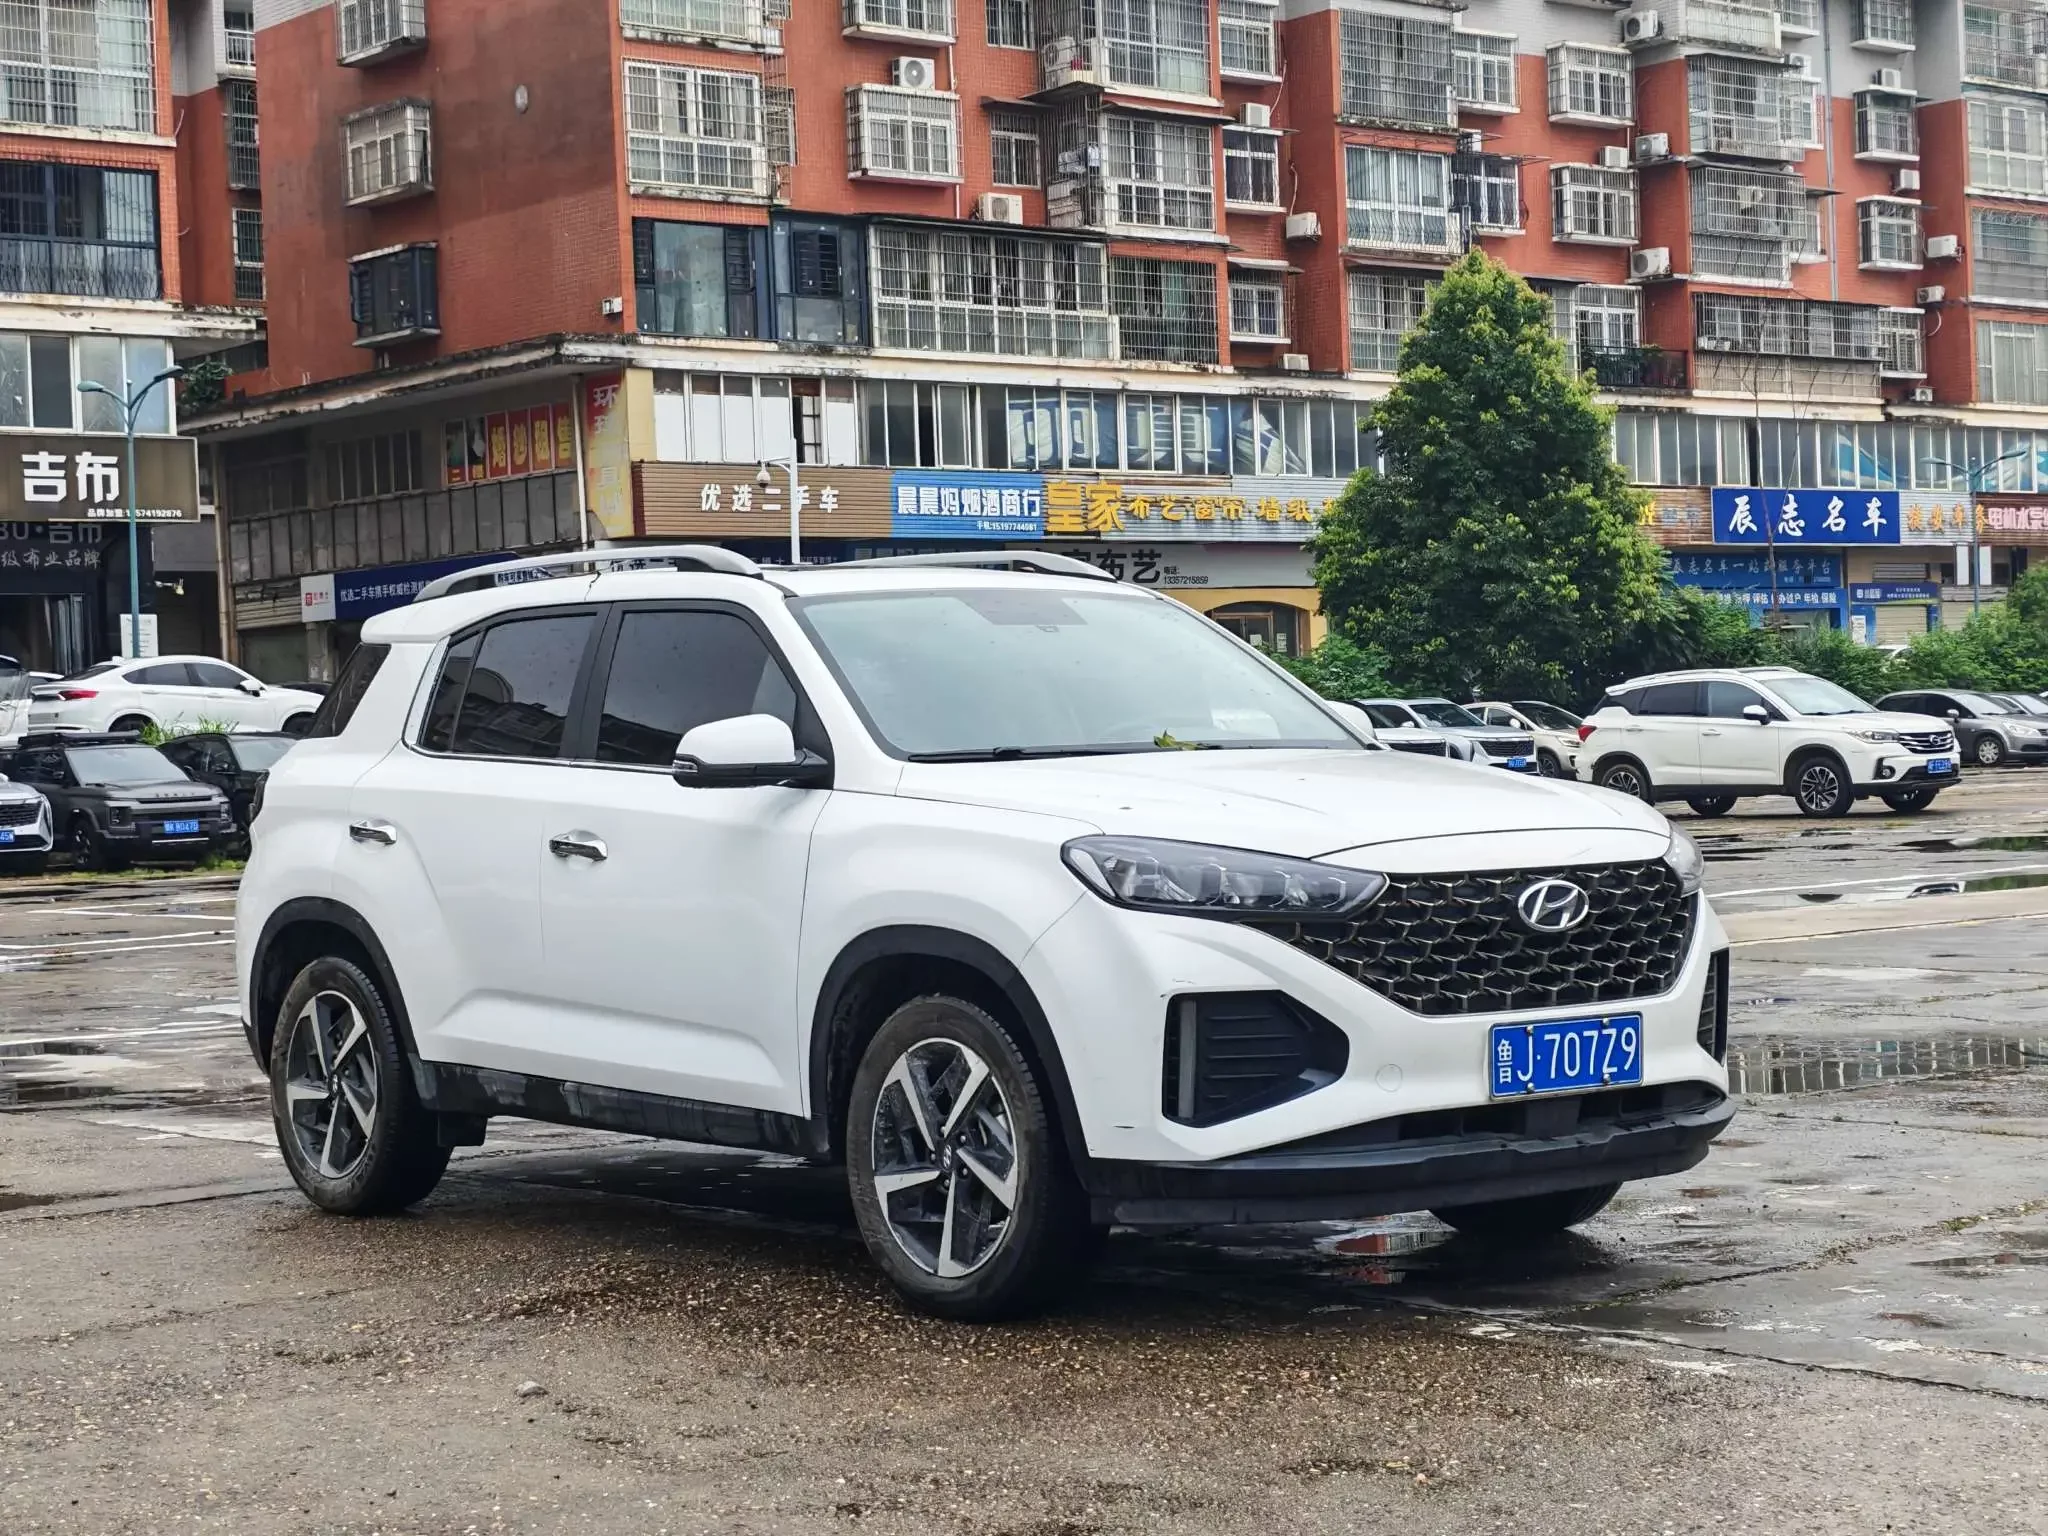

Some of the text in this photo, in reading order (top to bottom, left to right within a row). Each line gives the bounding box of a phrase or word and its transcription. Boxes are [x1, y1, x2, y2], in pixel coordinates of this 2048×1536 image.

[21, 451, 120, 504] 吉布
[701, 484, 839, 514] 优选二手车
[897, 486, 1041, 517] 晨晨妈烟酒商行
[1047, 481, 1125, 532] 皇家
[1729, 494, 1888, 537] 辰志名车
